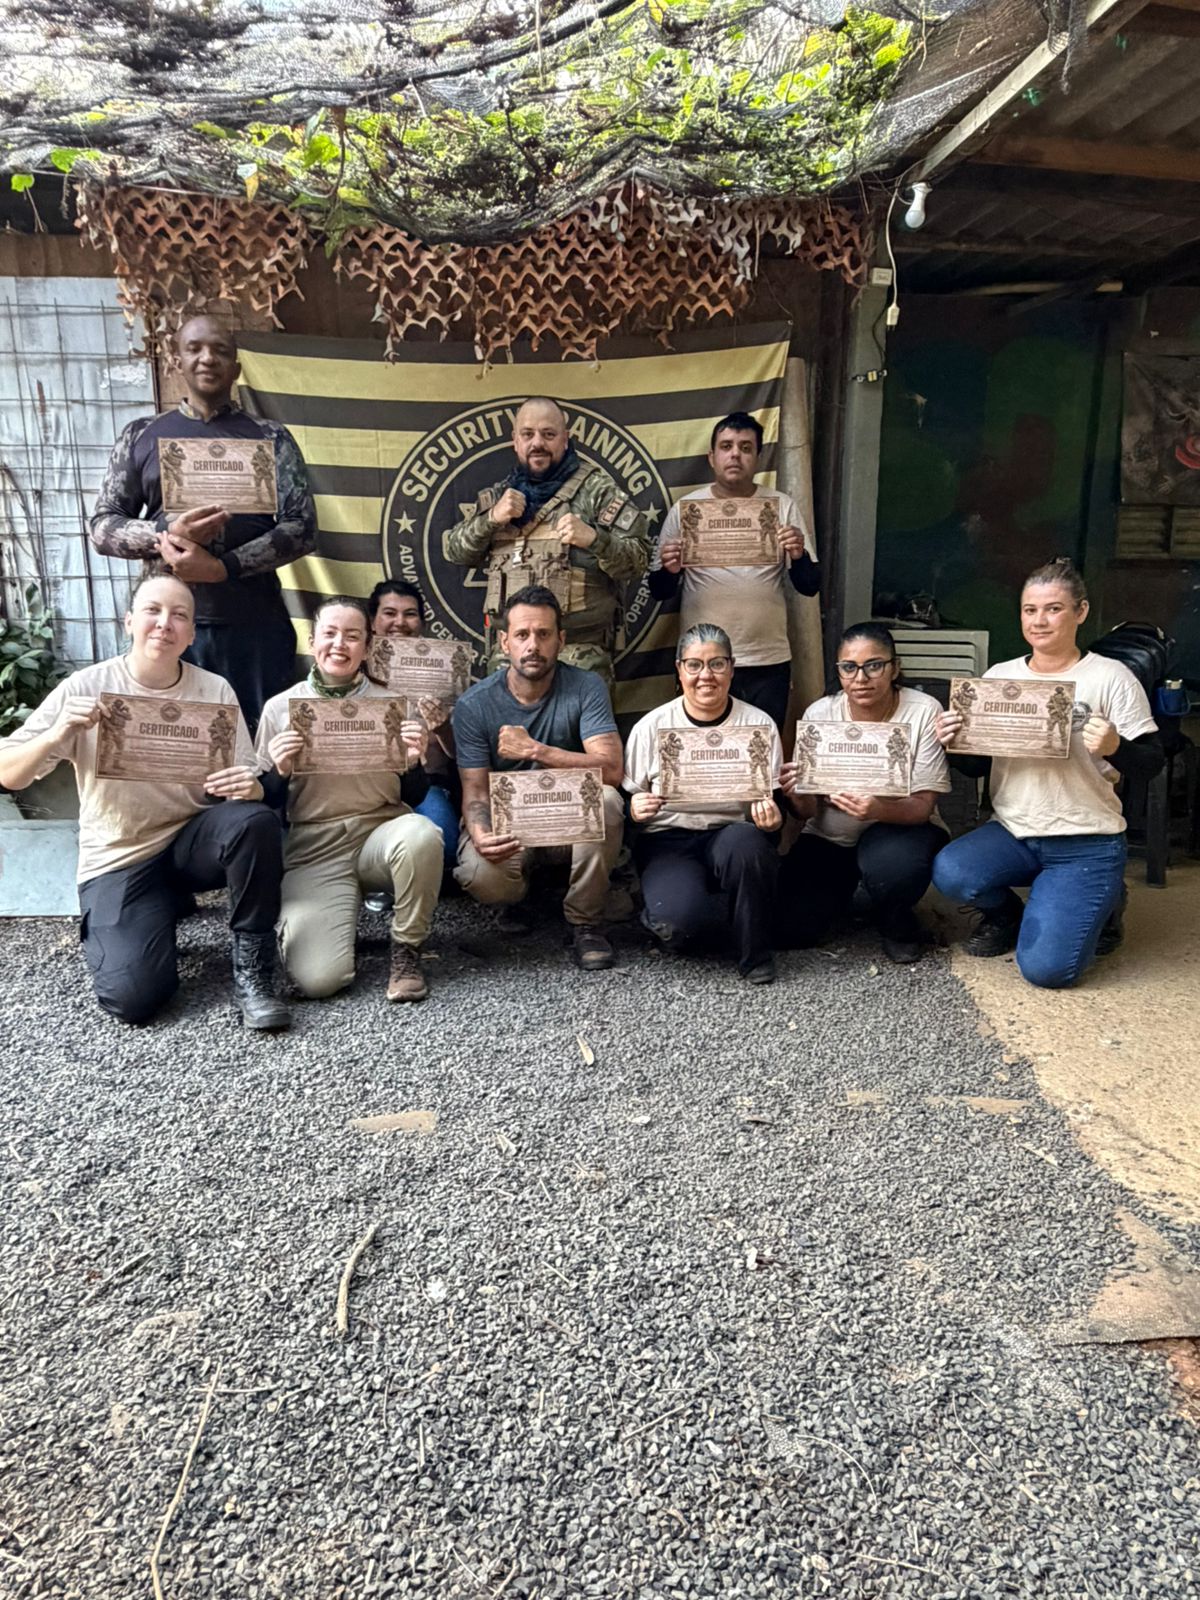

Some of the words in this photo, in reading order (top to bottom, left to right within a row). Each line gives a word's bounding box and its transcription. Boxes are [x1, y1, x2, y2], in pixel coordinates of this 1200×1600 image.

[563, 411, 652, 497] AINING
[193, 460, 244, 472] CERTIFICADO
[708, 518, 752, 529] CERTIFICADO
[400, 656, 444, 668] CERTIFICADO
[984, 701, 1038, 715] CERTIFICADO
[139, 722, 199, 739] CERTIFICADO
[324, 719, 376, 732] CERTIFICADO
[690, 748, 740, 761] CERTIFICADO
[828, 742, 879, 754] CERTIFICADO
[523, 791, 572, 805] CERTIFICADO
